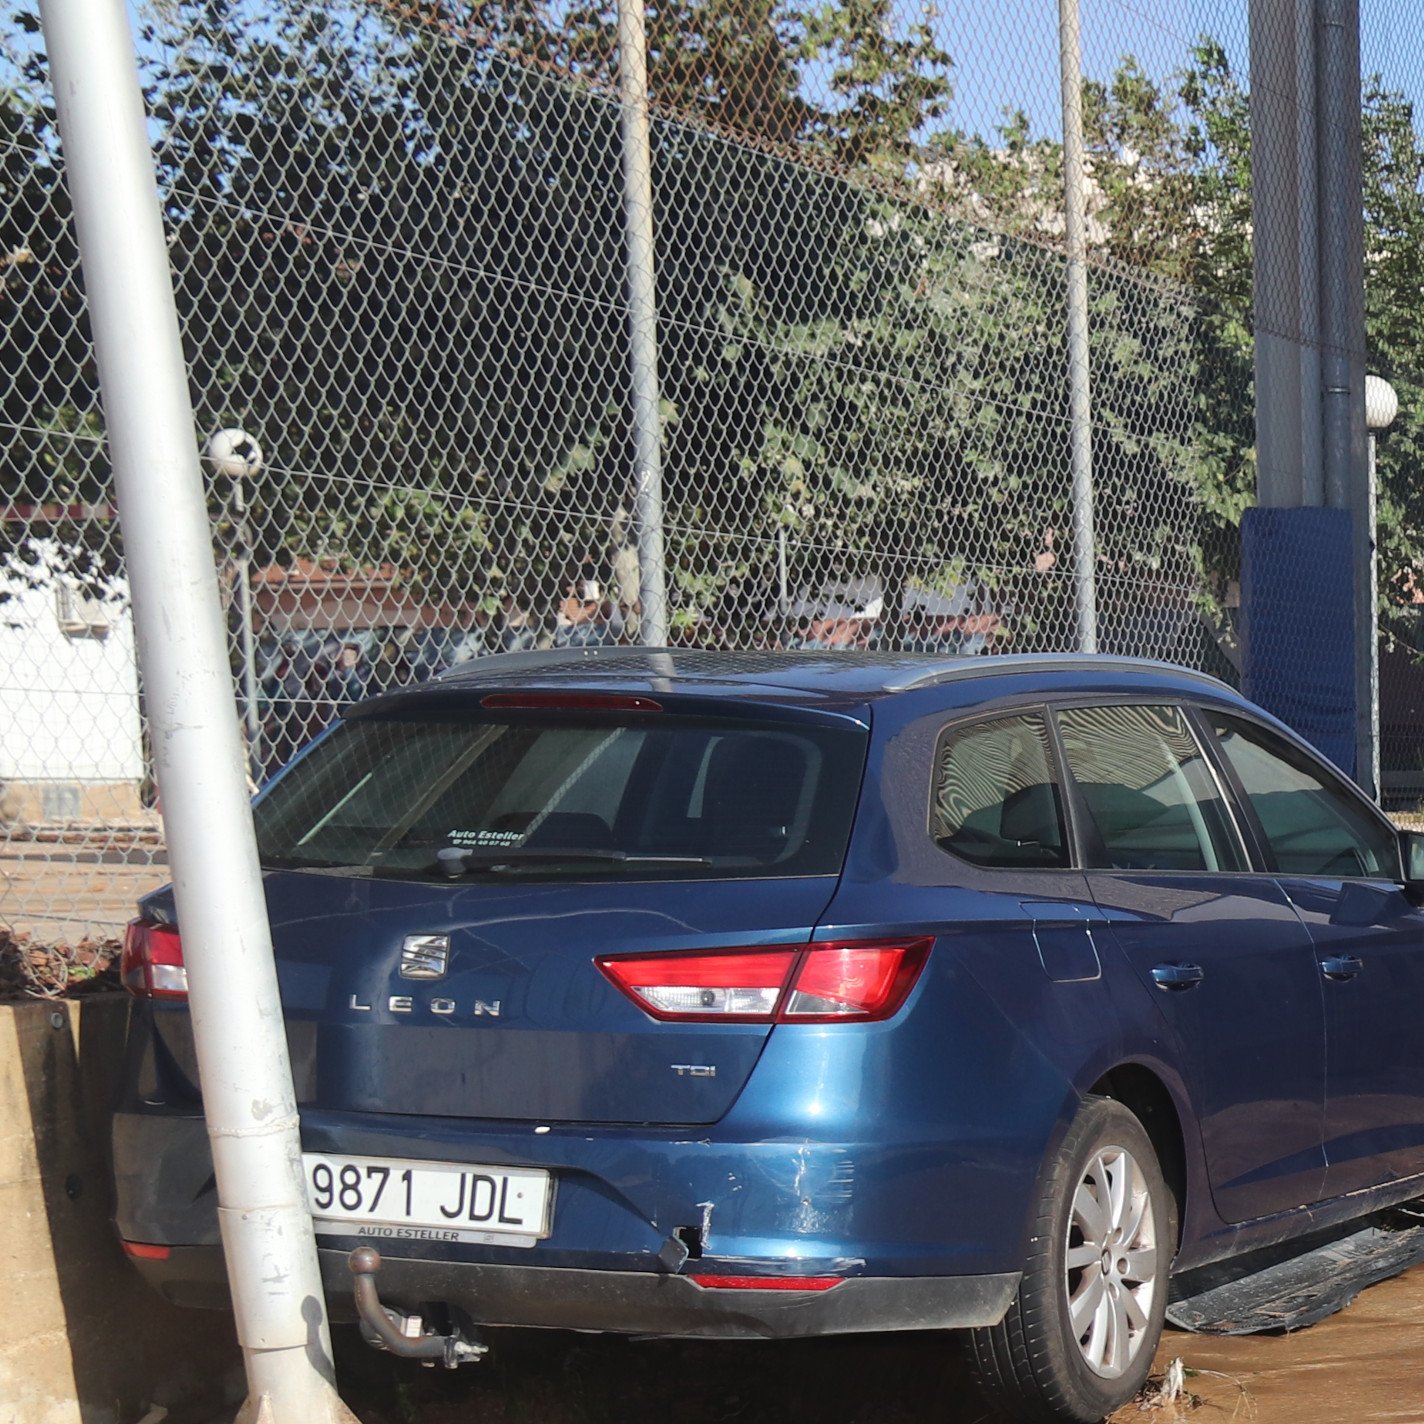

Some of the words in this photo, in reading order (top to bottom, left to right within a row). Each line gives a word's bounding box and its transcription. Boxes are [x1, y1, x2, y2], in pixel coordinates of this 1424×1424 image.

[447, 830, 476, 838] Auto
[478, 831, 525, 840] Esteller
[350, 994, 500, 1016] LEON
[671, 1065, 716, 1077] TDI
[313, 1163, 413, 1217] 9871
[440, 1172, 523, 1225] JDL
[358, 1227, 393, 1238] AUTO
[396, 1229, 459, 1241] ESTELLER
